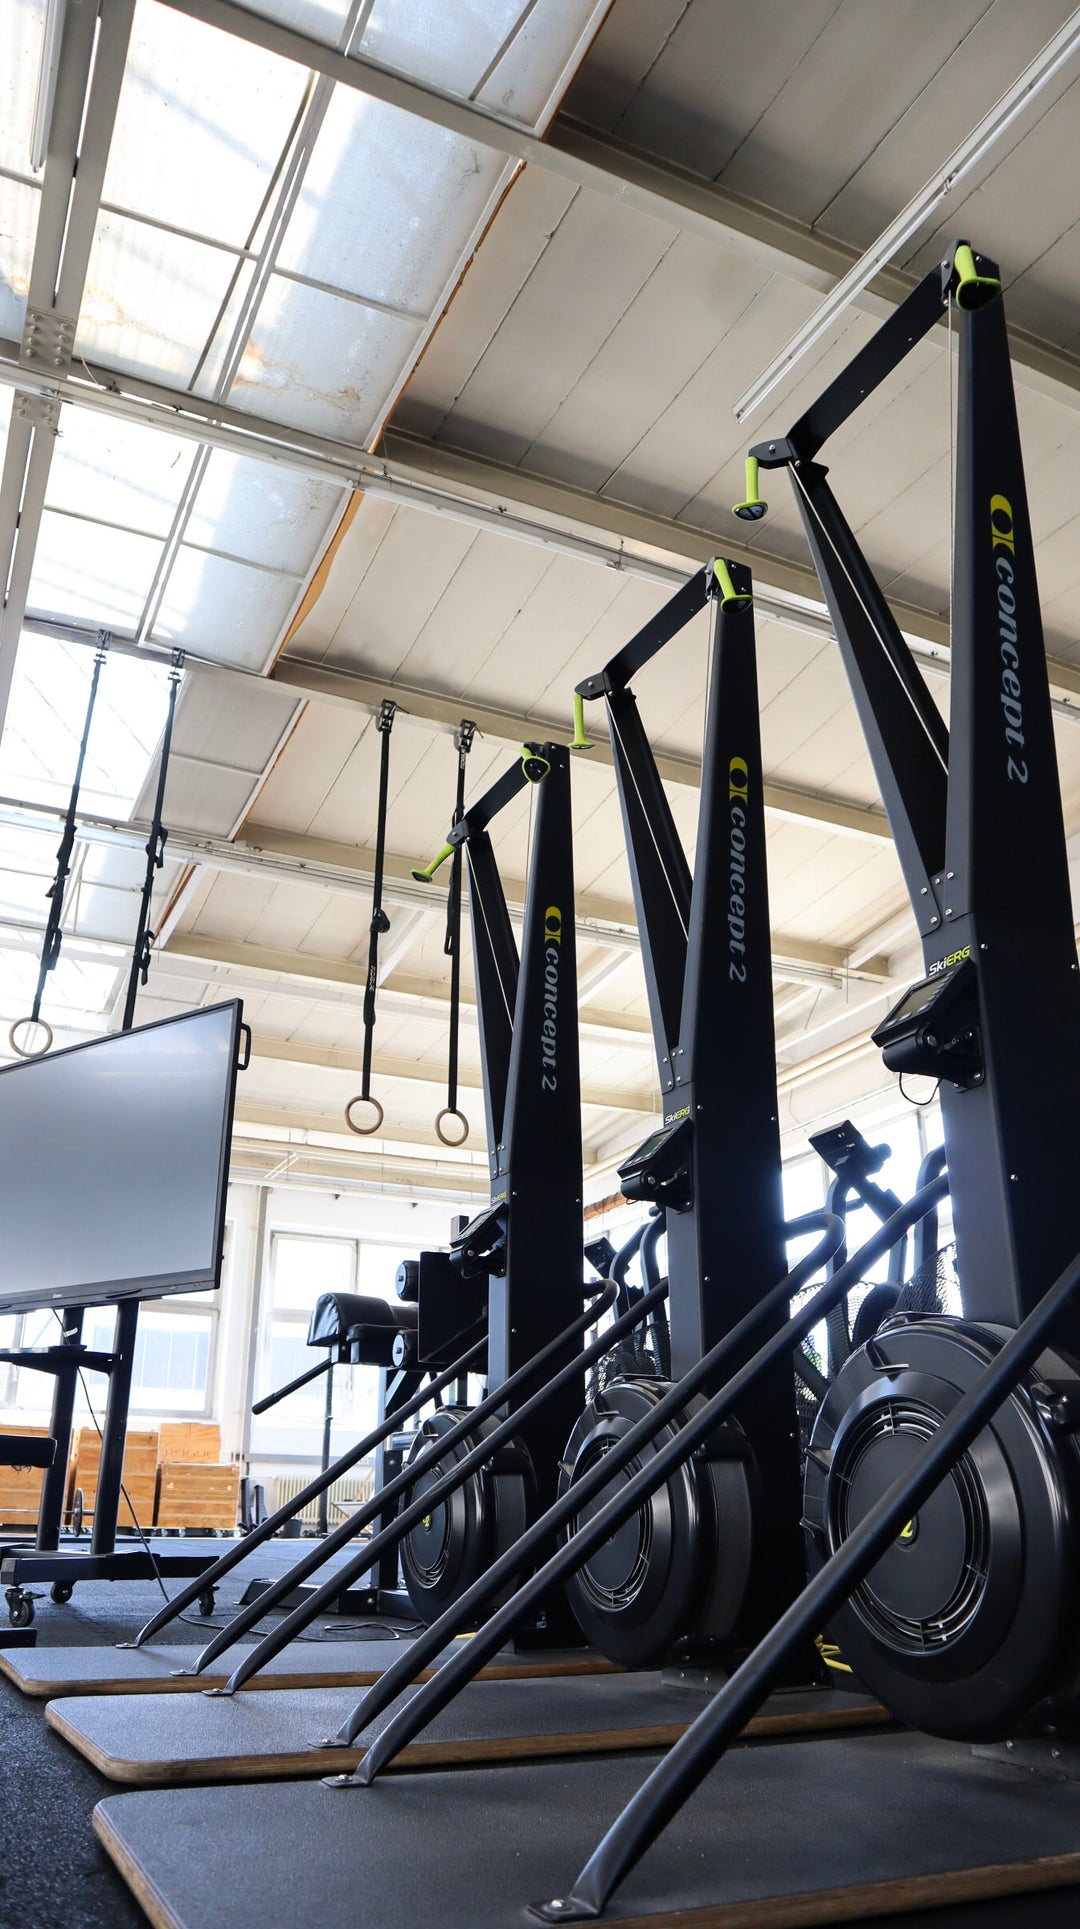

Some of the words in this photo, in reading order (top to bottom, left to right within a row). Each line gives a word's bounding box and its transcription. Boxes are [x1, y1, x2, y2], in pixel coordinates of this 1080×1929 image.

[995, 556, 1025, 747] concept
[1006, 755, 1028, 784] 2
[727, 806, 746, 955] concept
[728, 962, 747, 983] 2
[928, 944, 972, 977] SkiERG
[541, 947, 559, 1069] concept
[541, 1075, 557, 1091] 2
